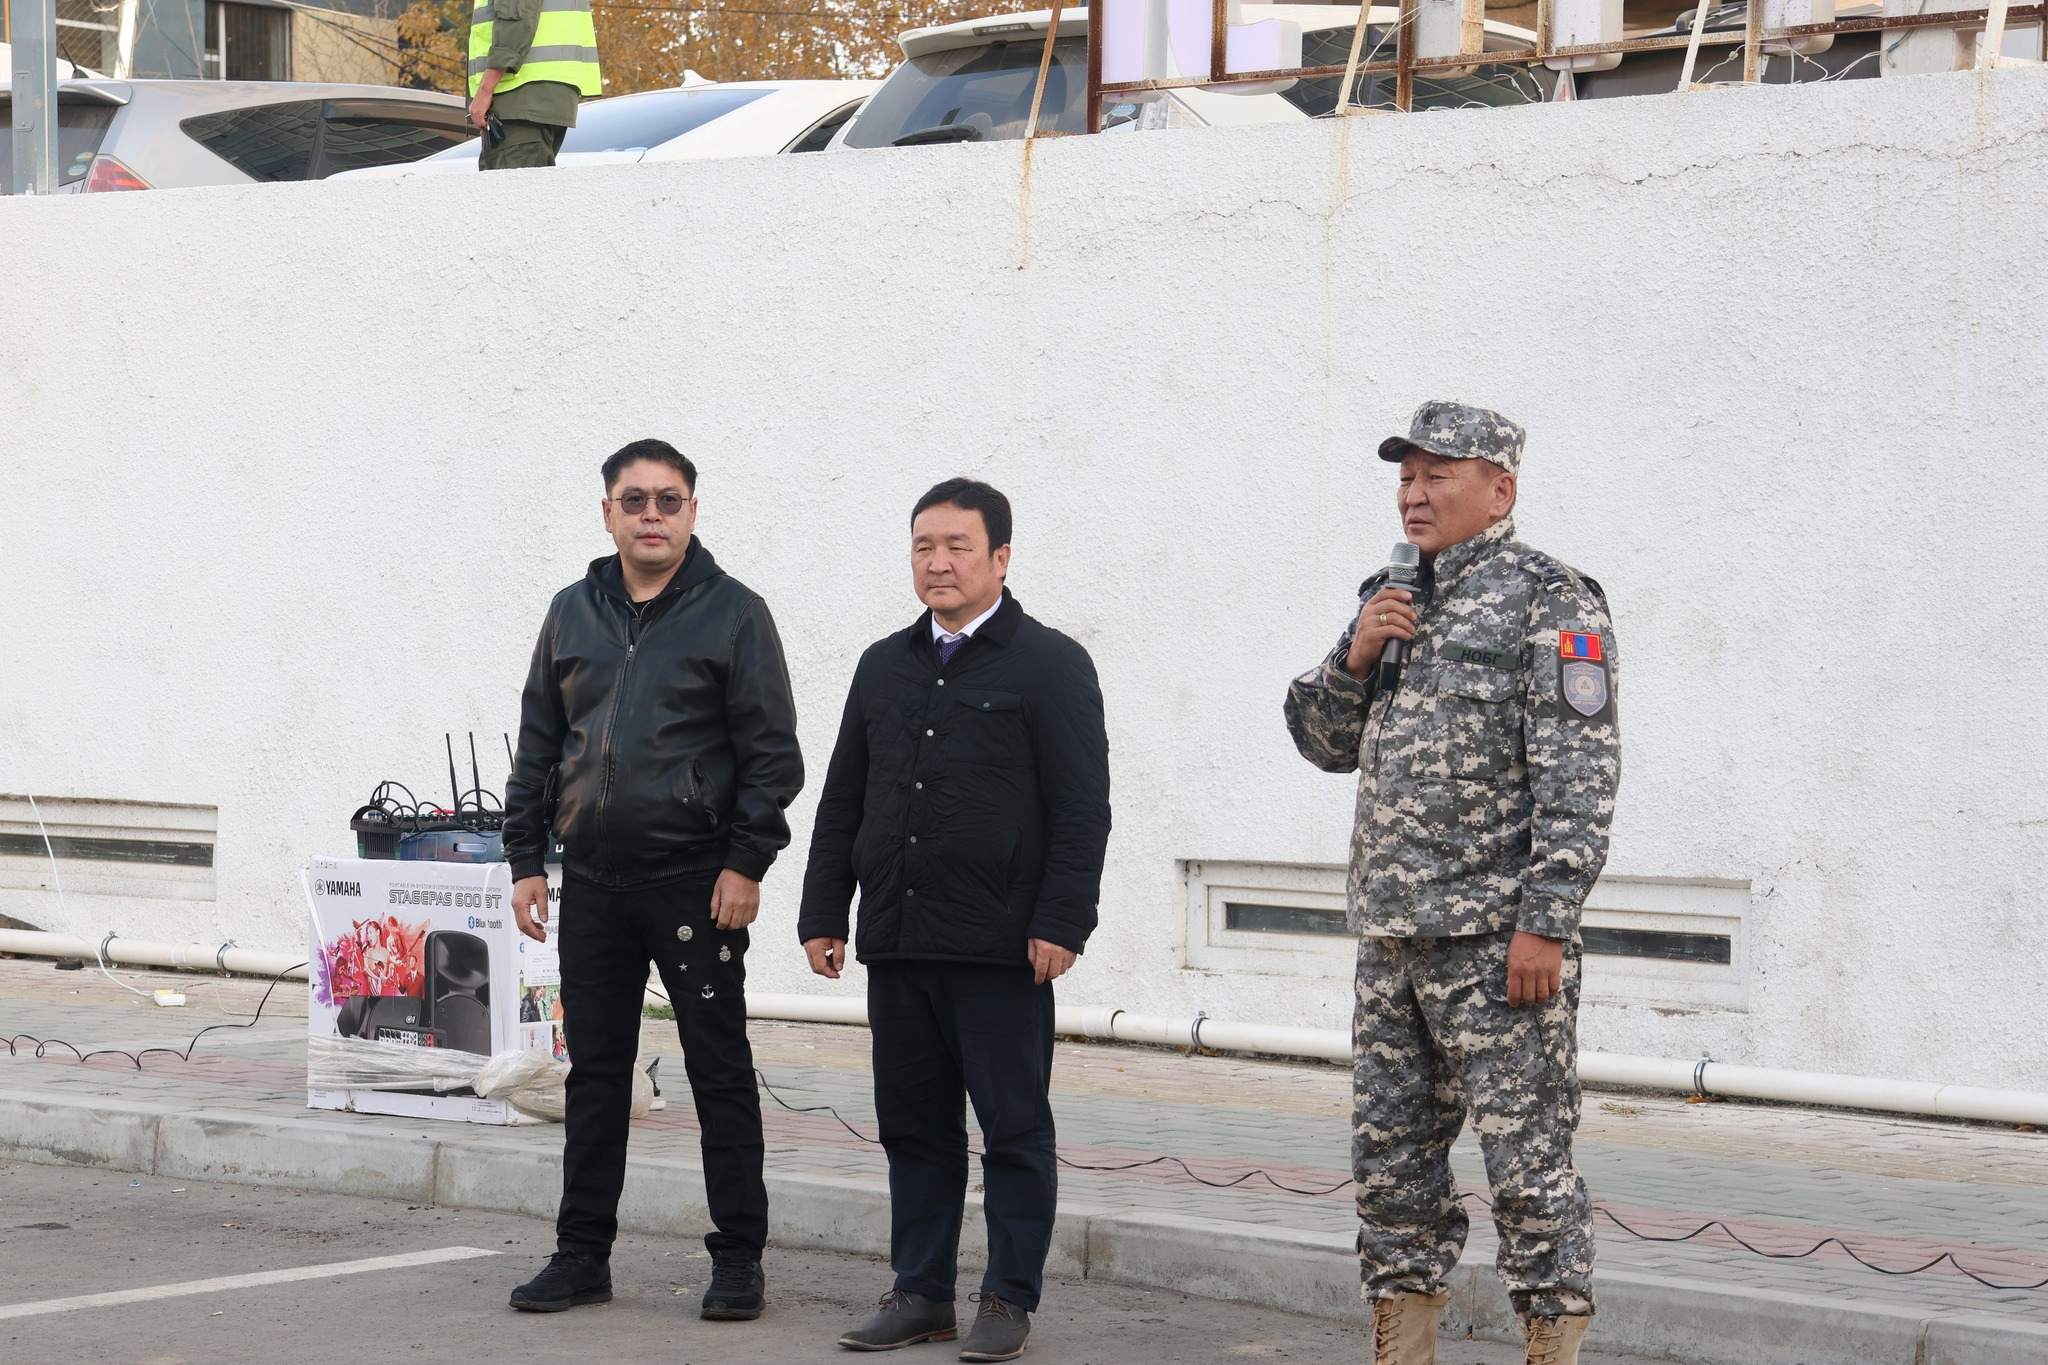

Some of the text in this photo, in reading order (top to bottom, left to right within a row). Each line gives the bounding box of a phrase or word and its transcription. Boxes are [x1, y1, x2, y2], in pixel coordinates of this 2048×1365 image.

[1461, 649, 1502, 665] НОБГ
[326, 880, 361, 896] YAMAHA
[389, 889, 452, 907] STAGEPAS
[455, 893, 481, 908] 600
[476, 918, 503, 929] Bluooth
